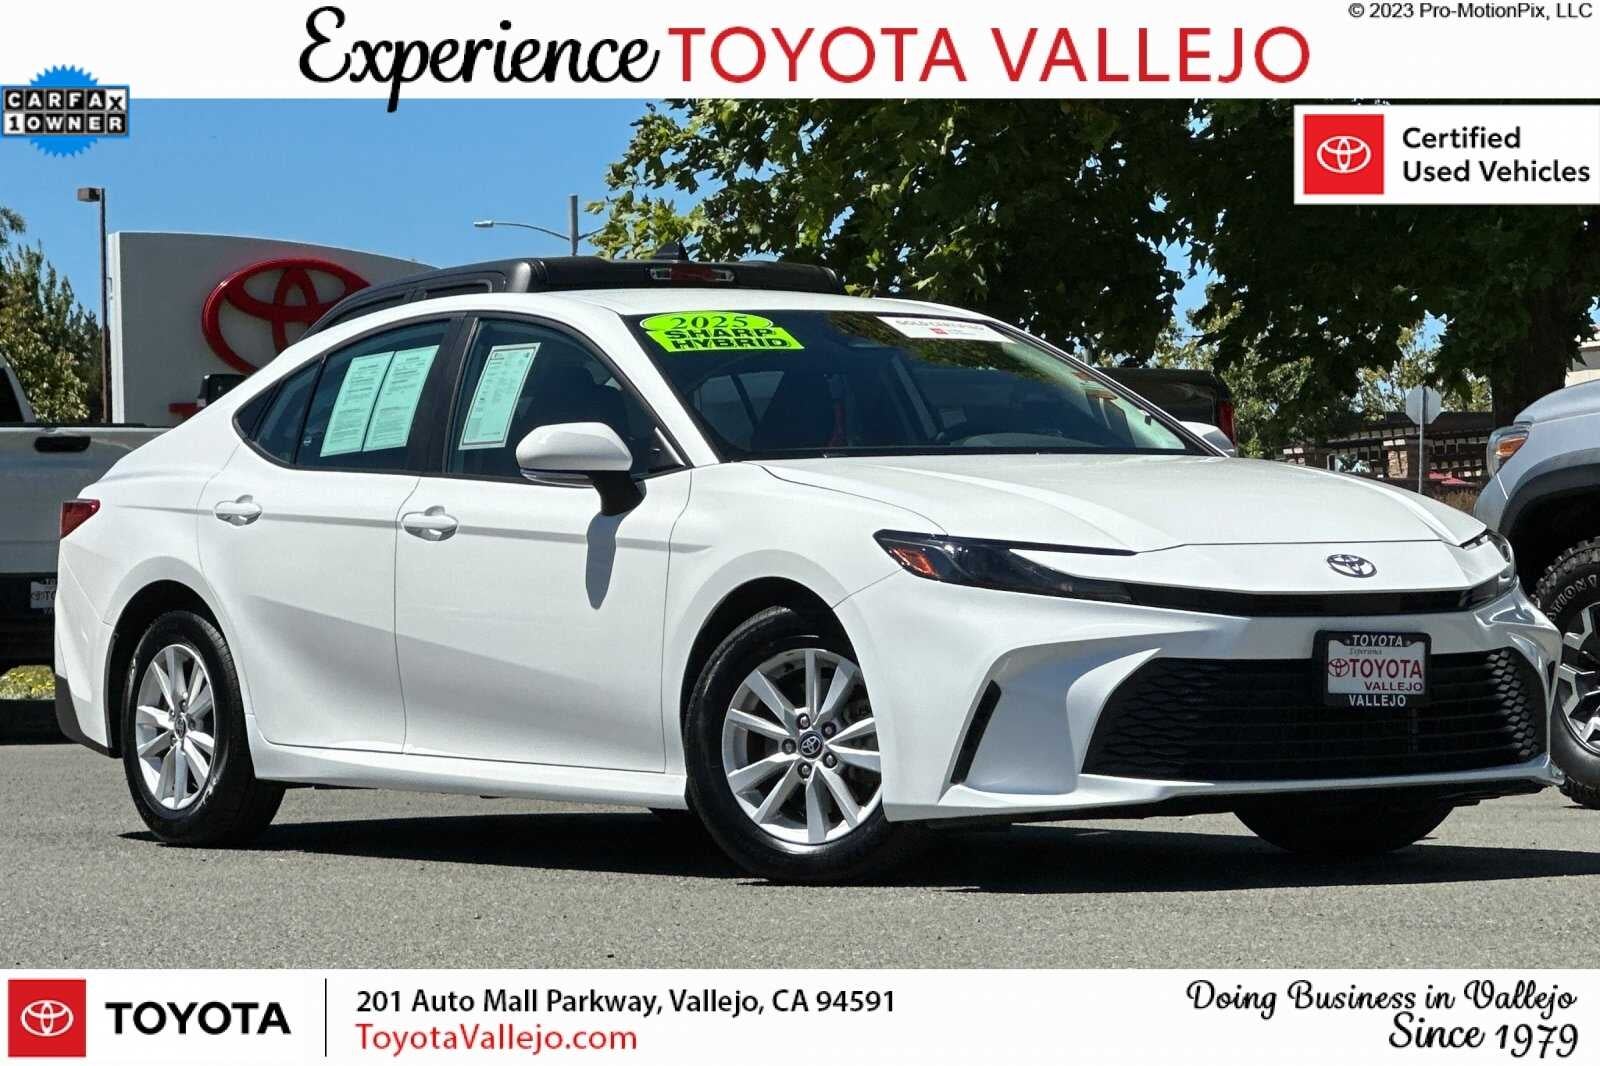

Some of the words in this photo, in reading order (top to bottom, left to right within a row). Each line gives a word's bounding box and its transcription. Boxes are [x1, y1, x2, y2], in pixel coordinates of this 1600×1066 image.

[670, 315, 749, 329] 2025
[664, 328, 776, 339] SHARP
[670, 338, 790, 349] HYBRID
[1352, 634, 1403, 647] TOYOTA
[1349, 659, 1423, 678] TOYOTA
[1364, 681, 1423, 691] VALLEJO
[1348, 694, 1406, 707] VALLEJO
